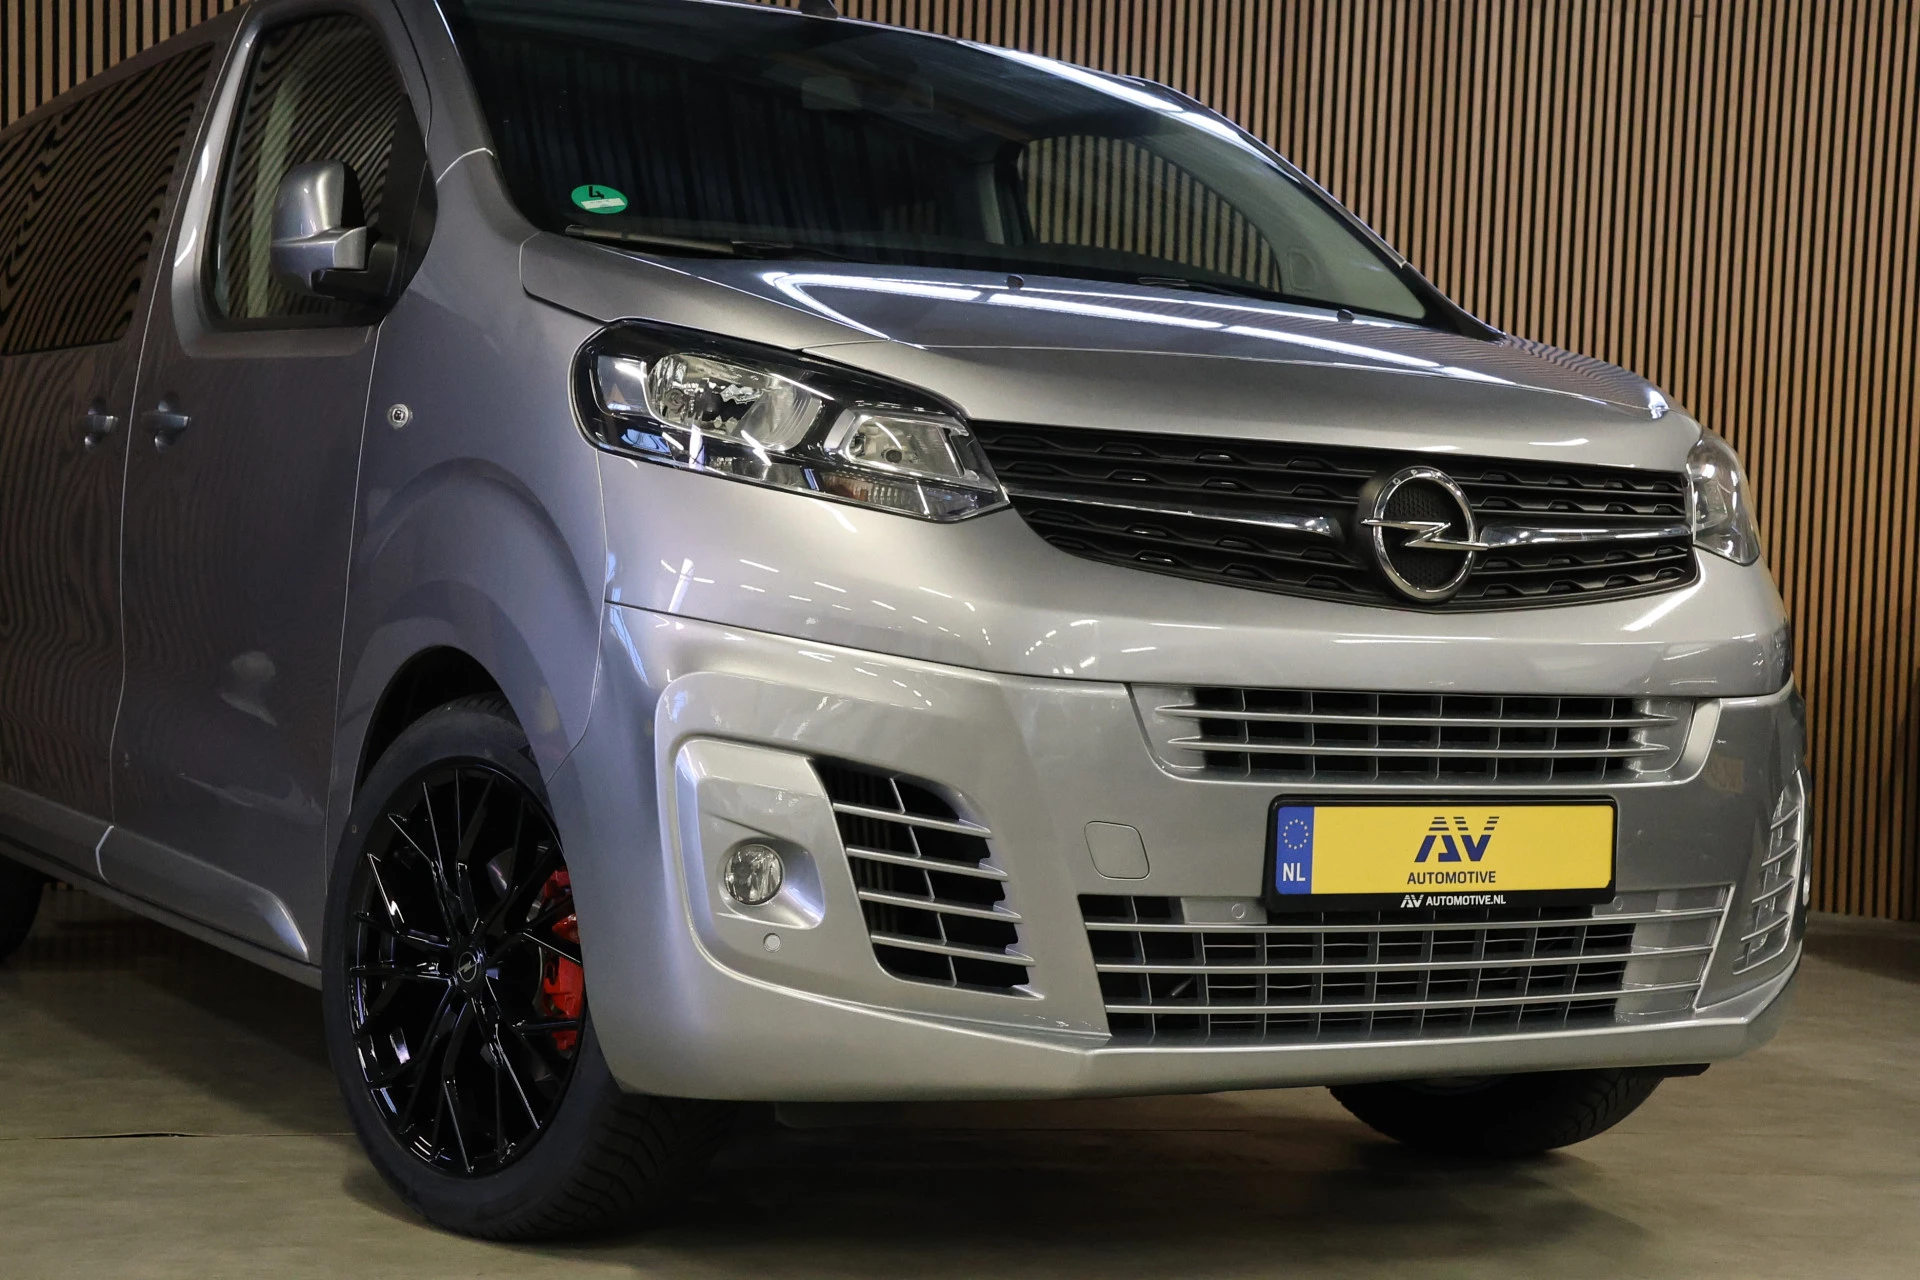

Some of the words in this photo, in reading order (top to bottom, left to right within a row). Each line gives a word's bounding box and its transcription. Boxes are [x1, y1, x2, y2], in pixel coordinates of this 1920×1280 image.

[588, 185, 605, 199] 4
[1414, 816, 1500, 862] AV
[1282, 863, 1306, 882] NL
[1407, 871, 1497, 885] AUTOMOTIVE
[1400, 894, 1424, 908] AV
[1425, 894, 1507, 906] AUTOMOTIVE.NL
